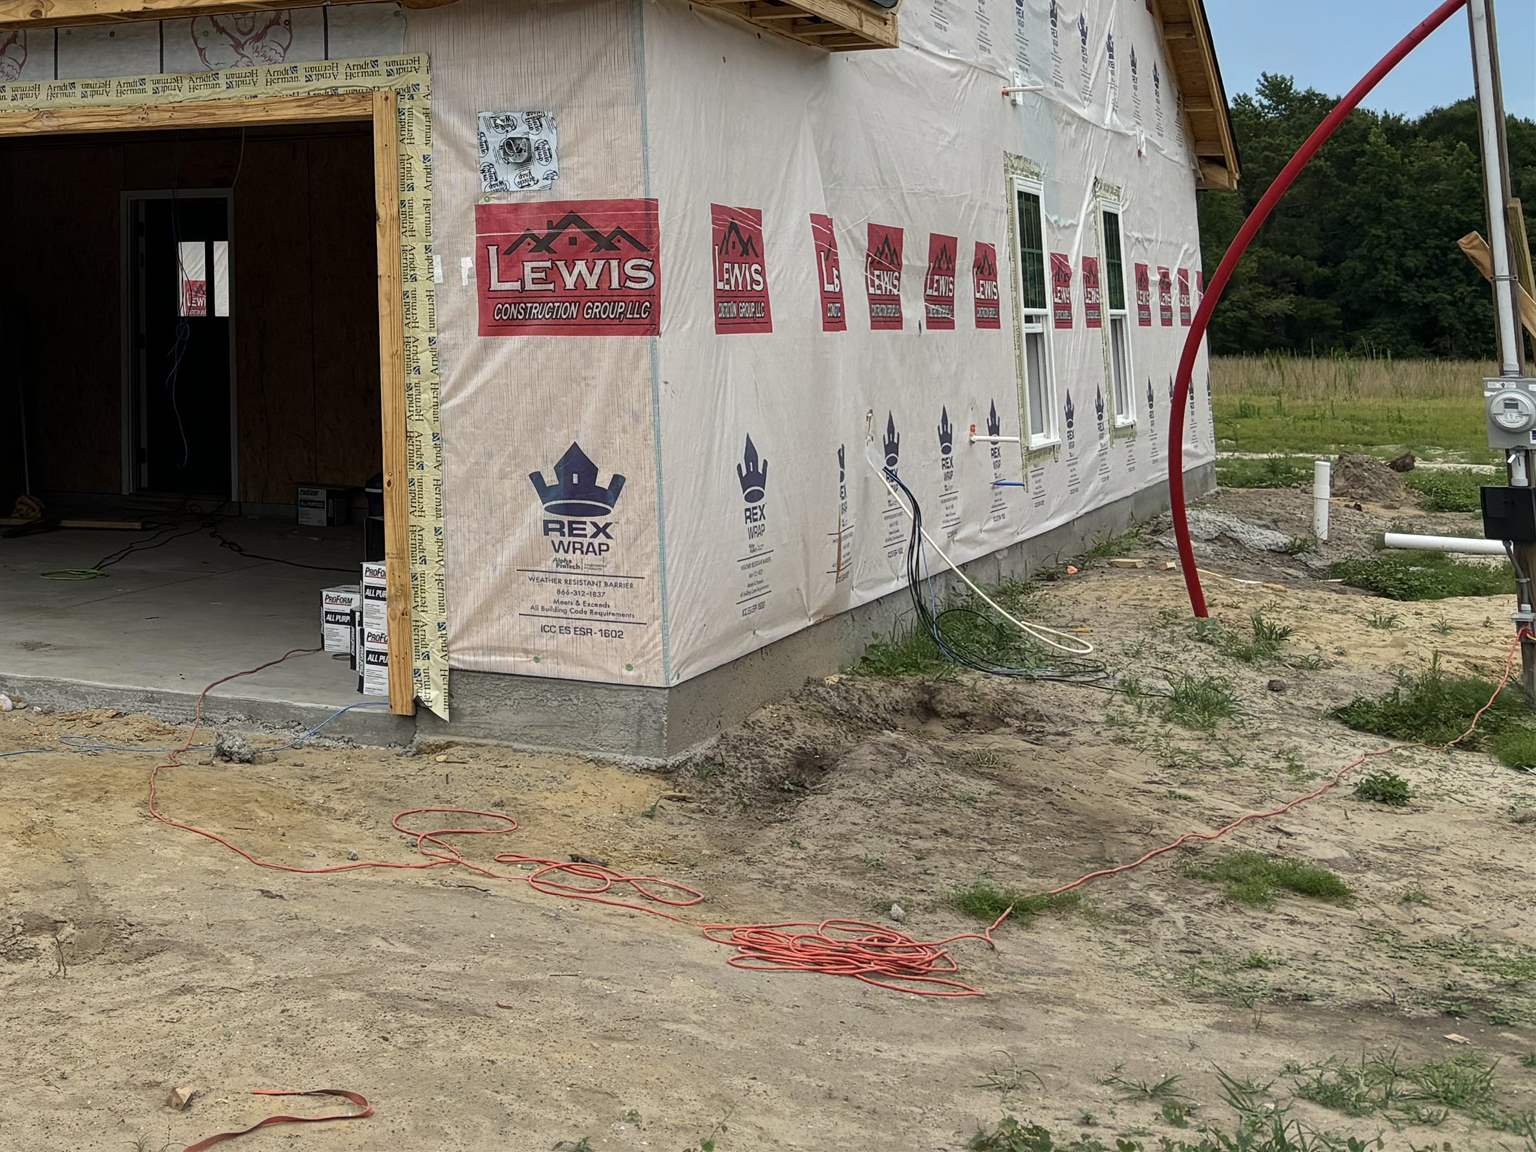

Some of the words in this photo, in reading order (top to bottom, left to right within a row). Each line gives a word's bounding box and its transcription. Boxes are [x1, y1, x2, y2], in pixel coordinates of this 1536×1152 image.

[485, 244, 656, 292] LEWIS
[714, 245, 764, 291] LEWIS
[866, 256, 901, 295] LEWIS
[926, 262, 954, 297] LEWIS
[974, 267, 998, 300] LEWIS
[494, 302, 579, 320] CONSTRUCTION
[942, 456, 954, 470] REX
[744, 503, 766, 524] REX
[543, 519, 614, 539] REX
[747, 524, 766, 540] WRAP
[551, 540, 610, 556] WRAP
[528, 575, 562, 585] WEATHER
[564, 577, 601, 588] RESISTANT
[604, 580, 634, 589] BARRIER
[365, 588, 375, 597] ALL
[556, 589, 606, 598] 866-312-1837
[541, 605, 567, 615] Building
[569, 607, 588, 616] Code
[590, 608, 635, 619] Requirements
[582, 600, 610, 609] Exceeds
[325, 614, 335, 622] ALL
[540, 624, 557, 634] ICC
[559, 625, 571, 635] ES
[367, 655, 377, 663] ALL
